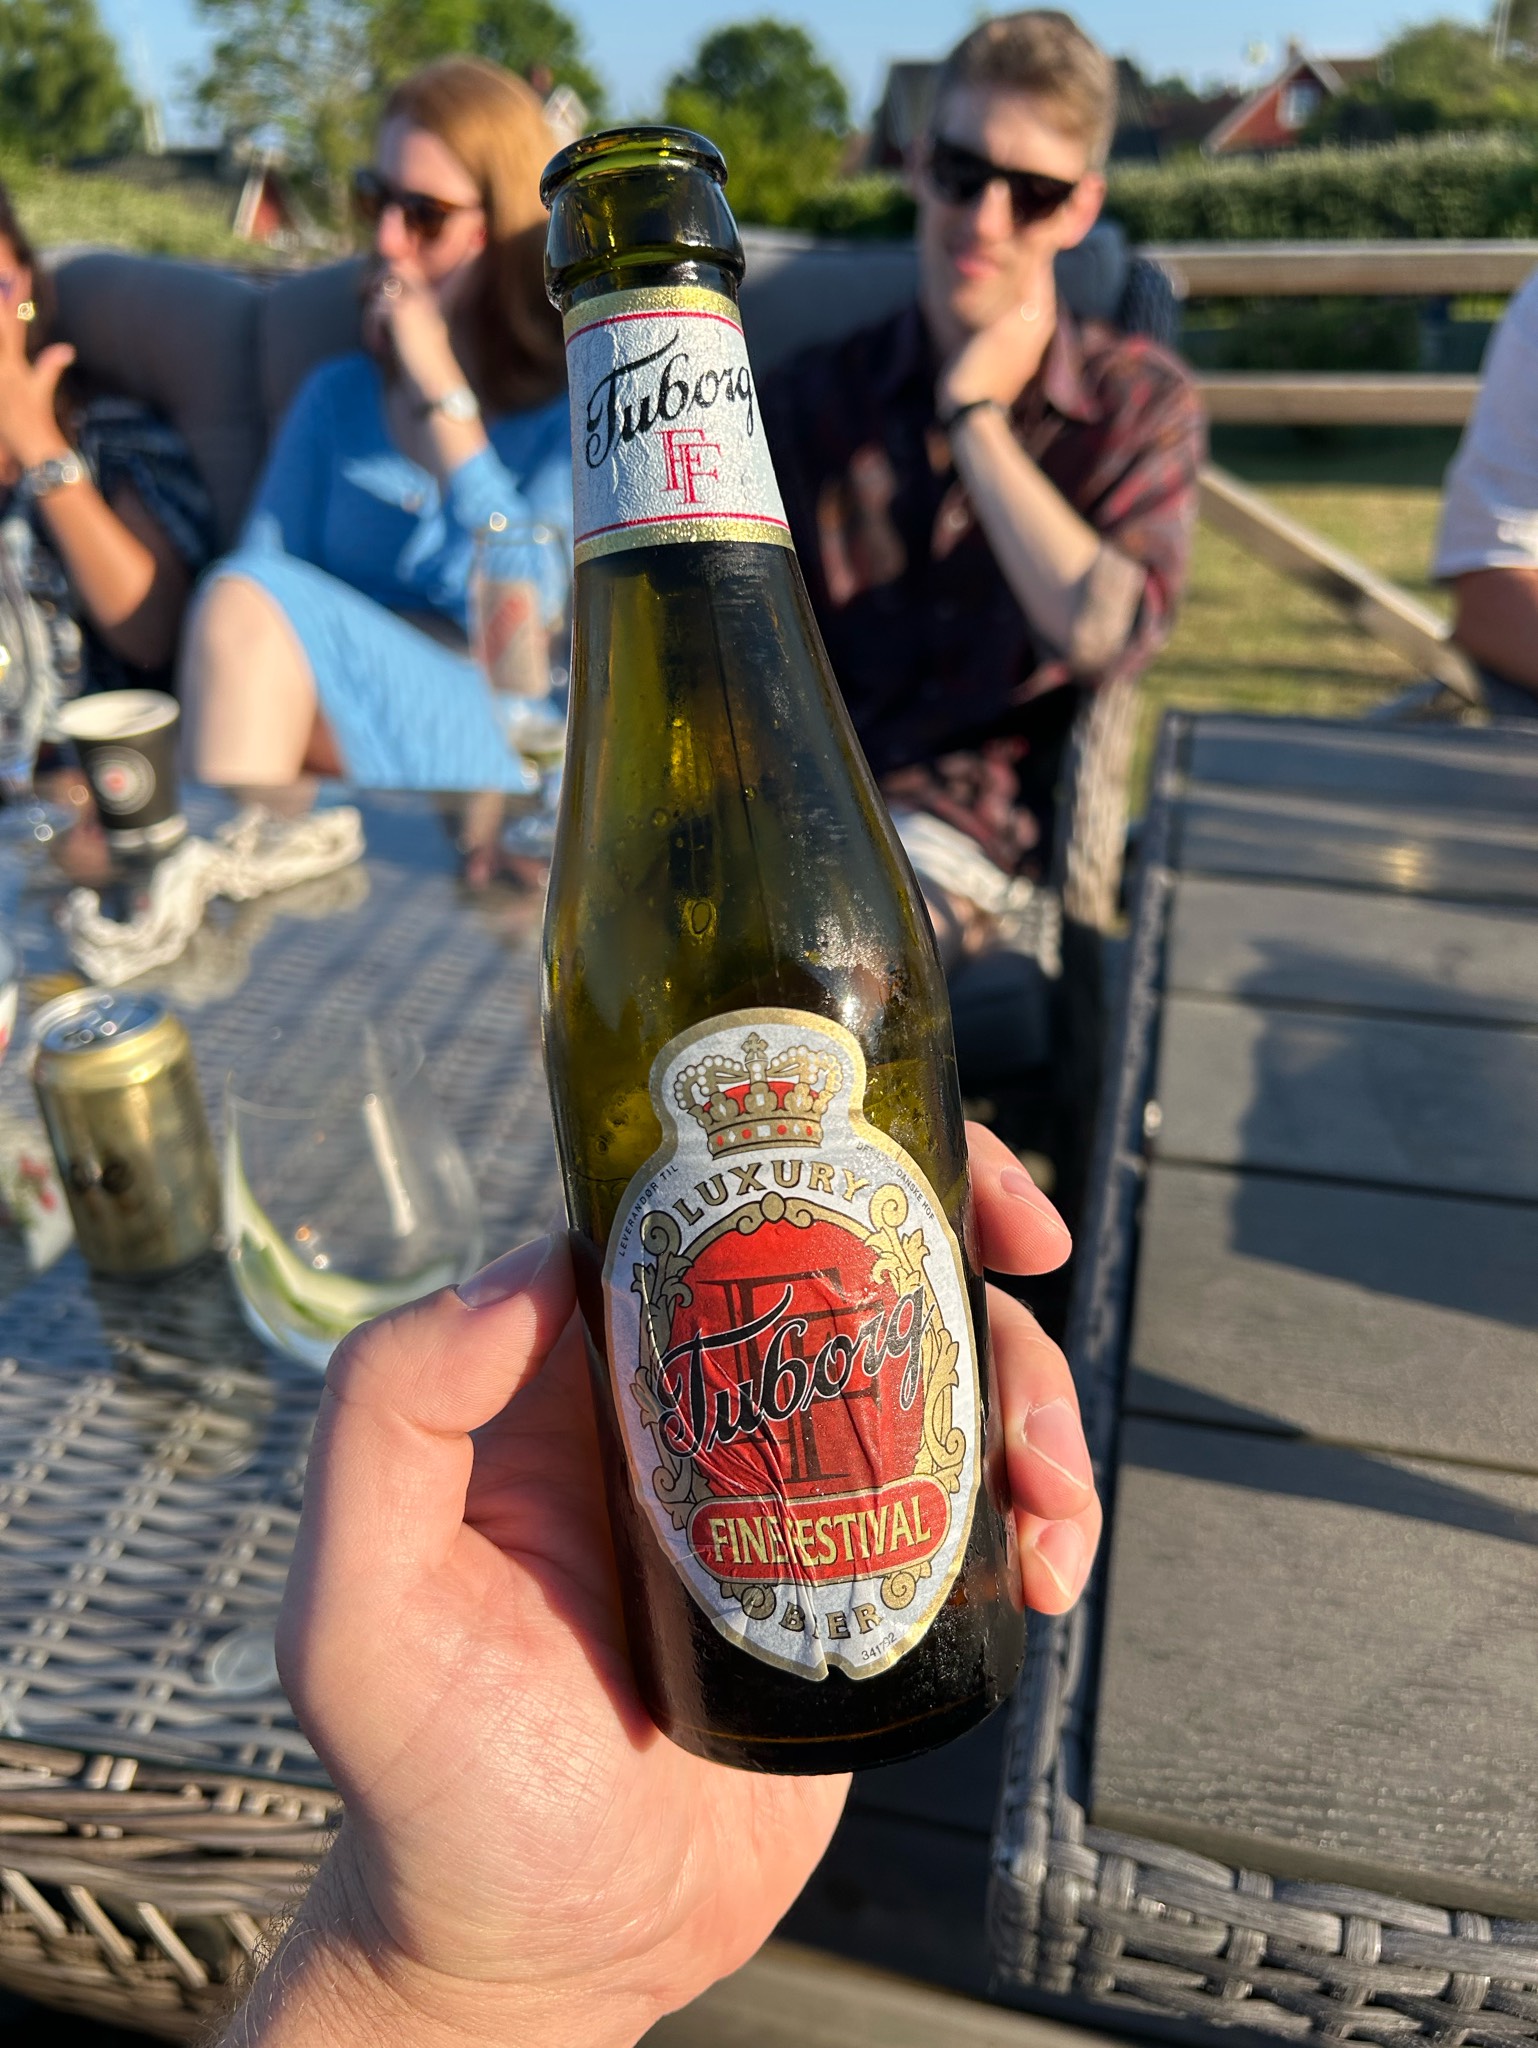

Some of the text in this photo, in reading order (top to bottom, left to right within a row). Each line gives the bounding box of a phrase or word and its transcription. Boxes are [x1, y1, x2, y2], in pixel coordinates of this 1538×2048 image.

[586, 328, 754, 469] Tuborg
[619, 1164, 679, 1257] LEVERANDØR TIL
[673, 1159, 871, 1226] LUXURY
[895, 1168, 924, 1202] DANSKE
[921, 1201, 935, 1220] HOF
[656, 1284, 937, 1460] Tuborg
[708, 1515, 789, 1565] FINE
[778, 1601, 884, 1640] BER
